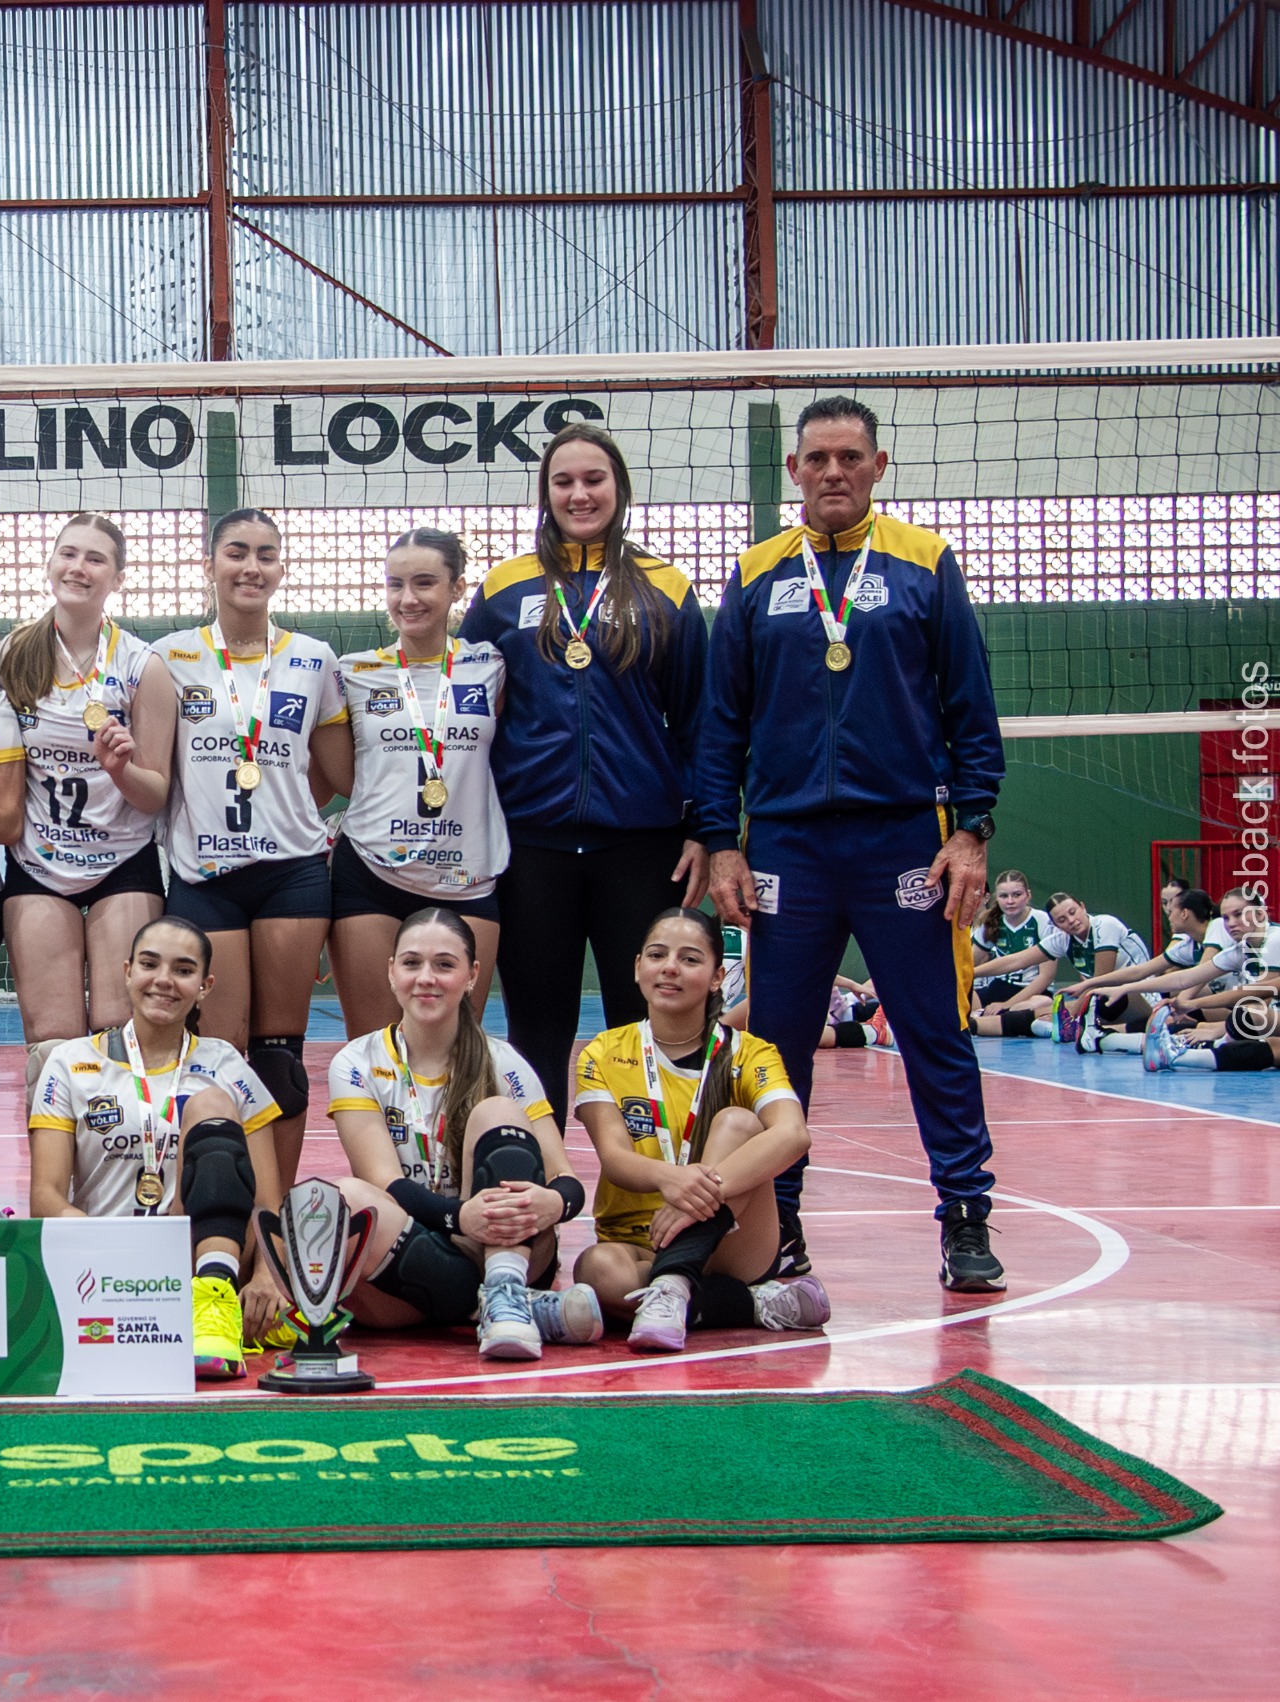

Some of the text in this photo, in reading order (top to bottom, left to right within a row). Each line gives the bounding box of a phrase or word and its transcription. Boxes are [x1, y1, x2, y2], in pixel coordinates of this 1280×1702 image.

[184, 705, 211, 715] VÔLEI
[40, 776, 93, 829] 12
[225, 769, 253, 833] 3
[390, 819, 463, 837] Plastlife
[197, 834, 278, 855] Plastlife
[408, 848, 464, 865] cegero
[904, 889, 938, 903] VÔLEI
[90, 1113, 119, 1127] VÔLEI
[101, 1275, 182, 1297] Fesporte
[117, 1322, 160, 1333] SANTA
[117, 1333, 183, 1344] CATARINA
[7, 1472, 301, 1488] CATARINENSE
[317, 1471, 375, 1481] DE
[389, 1468, 585, 1481] ESPORTE
